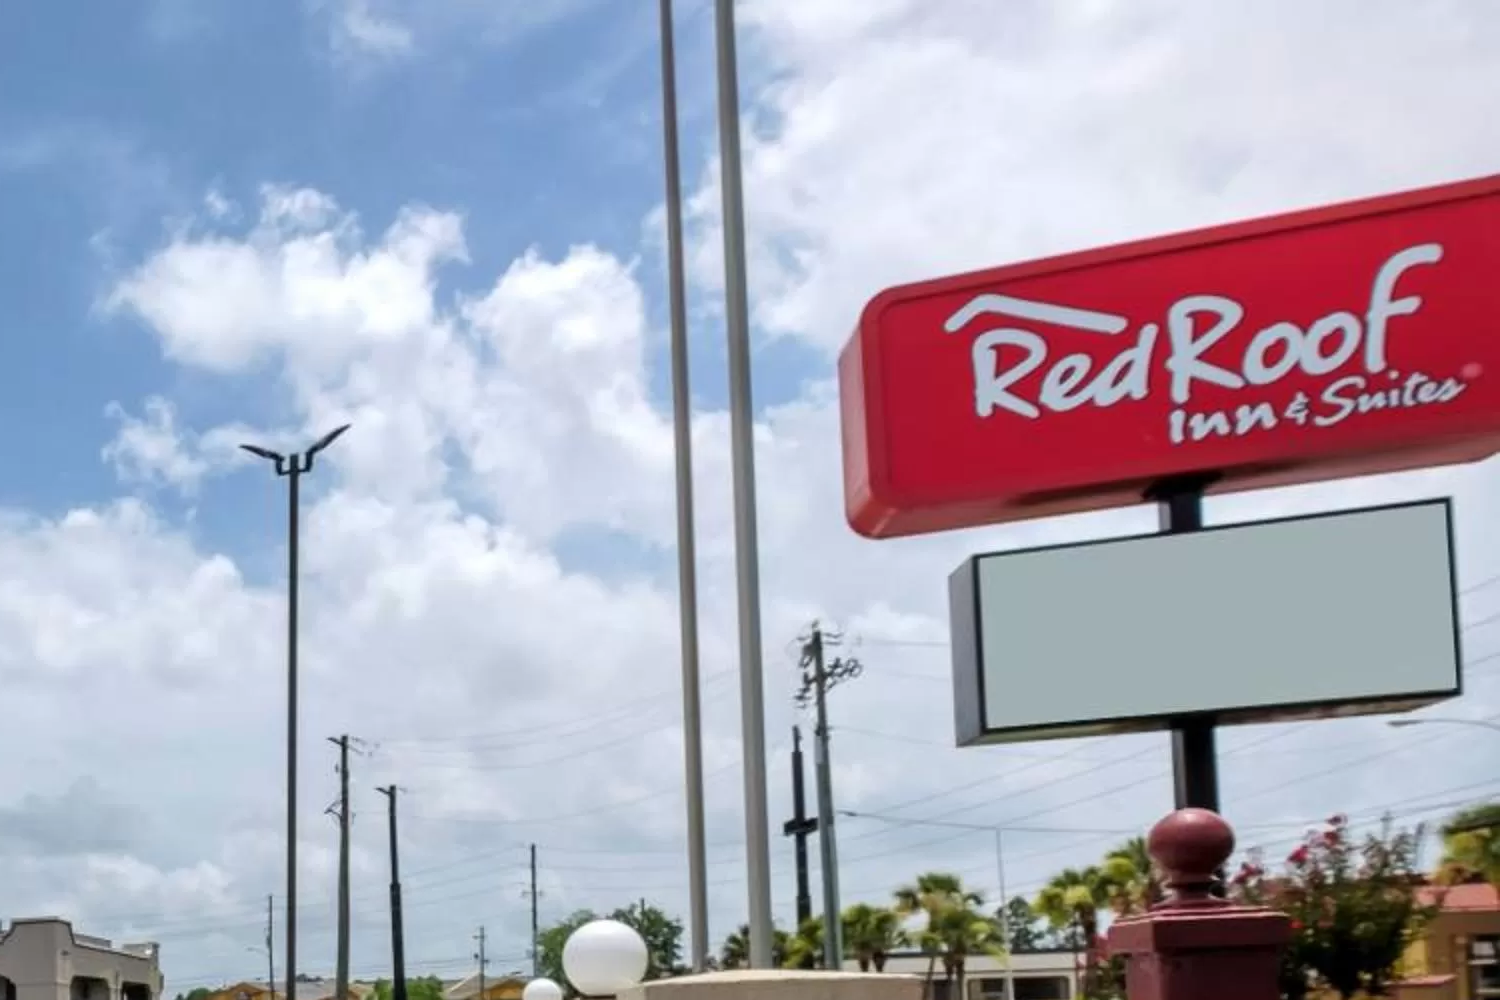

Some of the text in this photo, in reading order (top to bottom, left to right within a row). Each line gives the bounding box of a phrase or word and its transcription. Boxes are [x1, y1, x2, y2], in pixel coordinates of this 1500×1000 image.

[1168, 369, 1467, 445] Inn & Suites
